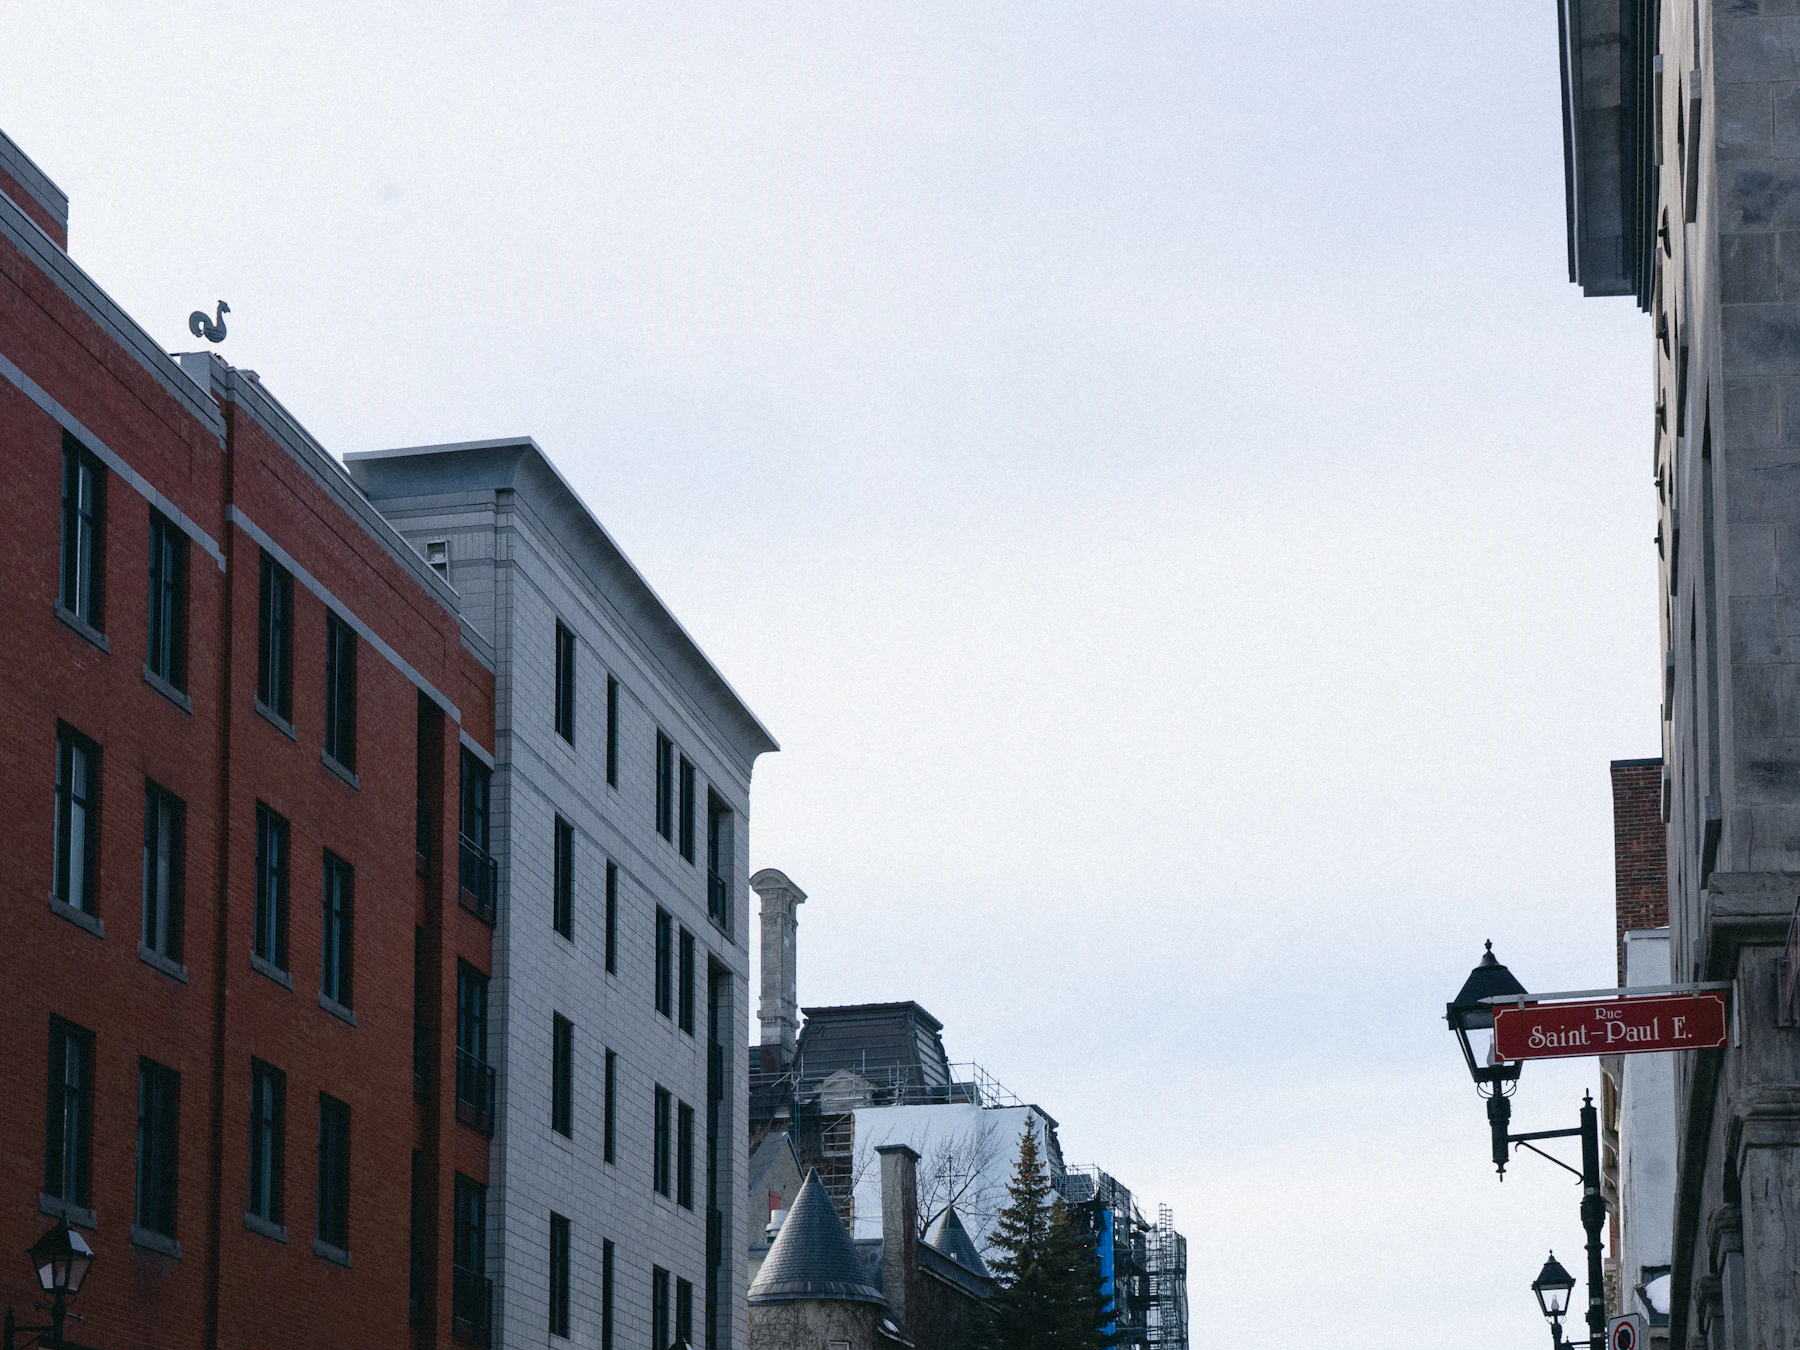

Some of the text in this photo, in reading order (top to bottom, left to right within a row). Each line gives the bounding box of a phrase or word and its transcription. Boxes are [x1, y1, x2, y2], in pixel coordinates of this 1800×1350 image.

[1595, 1008, 1623, 1020] Rue
[1528, 1016, 1693, 1048] Saint-Paul E.
